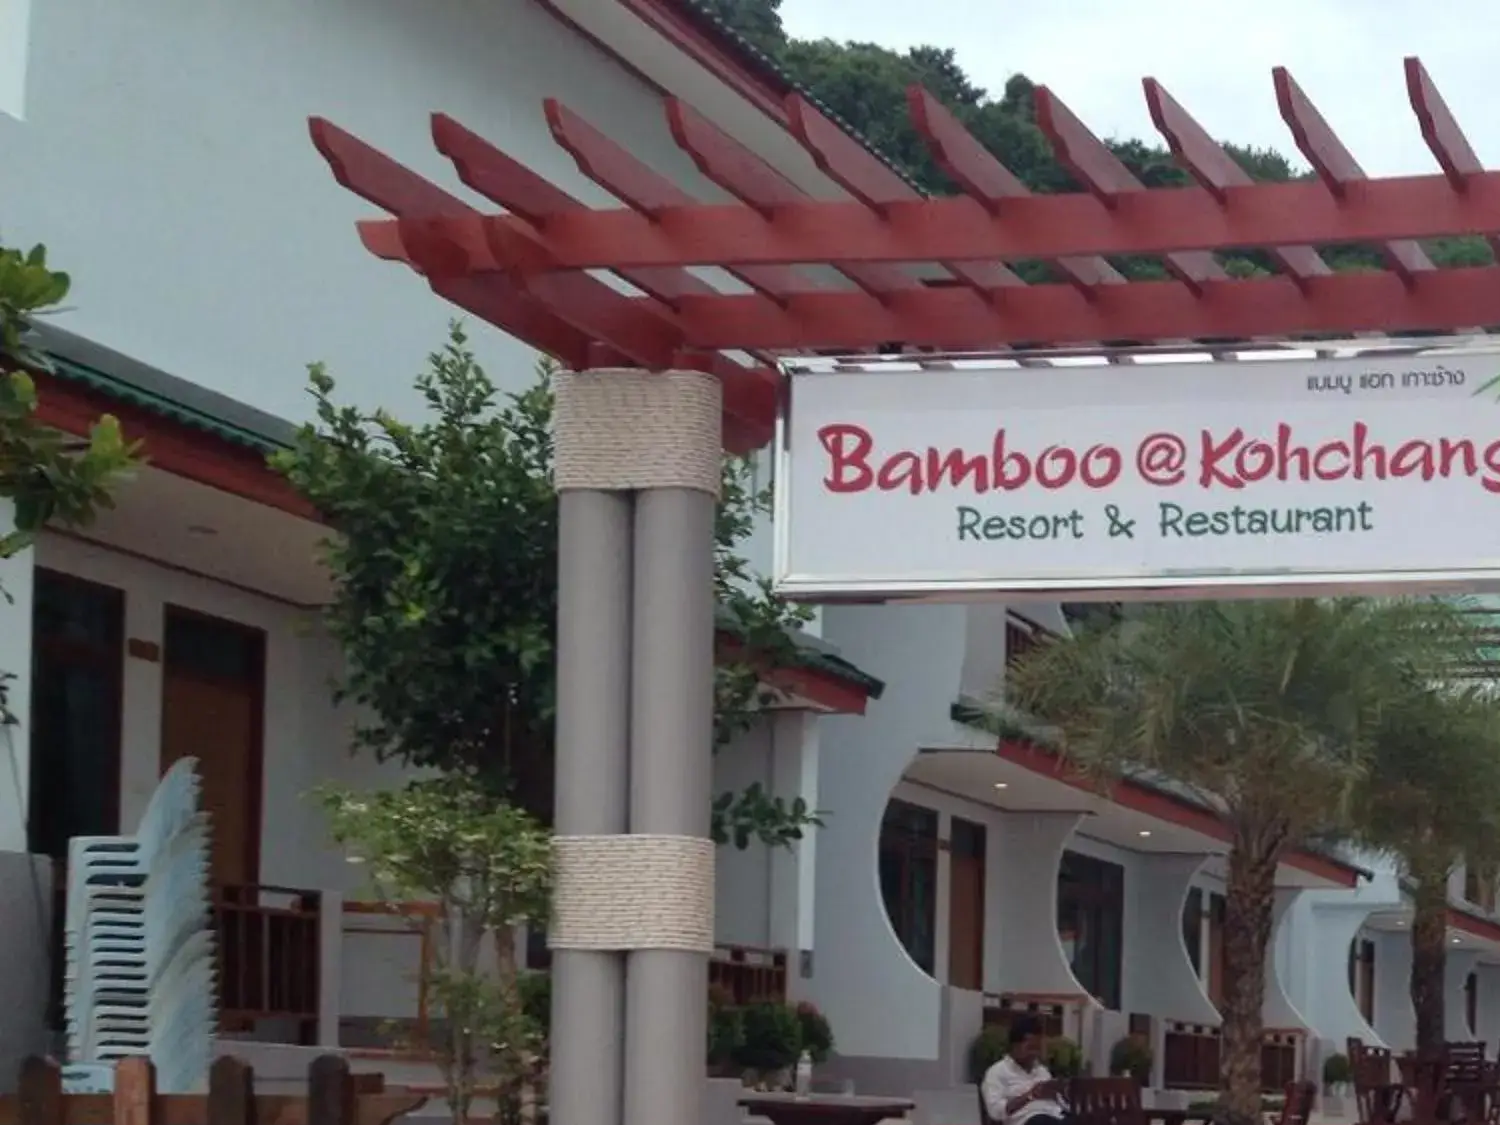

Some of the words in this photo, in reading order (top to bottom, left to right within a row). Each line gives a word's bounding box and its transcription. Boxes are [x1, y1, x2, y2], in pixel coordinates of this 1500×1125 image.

[818, 424, 1122, 493] Bamboo
[957, 504, 1085, 541] Resort
[1105, 504, 1137, 539] &
[1159, 500, 1375, 537] Restaurant
